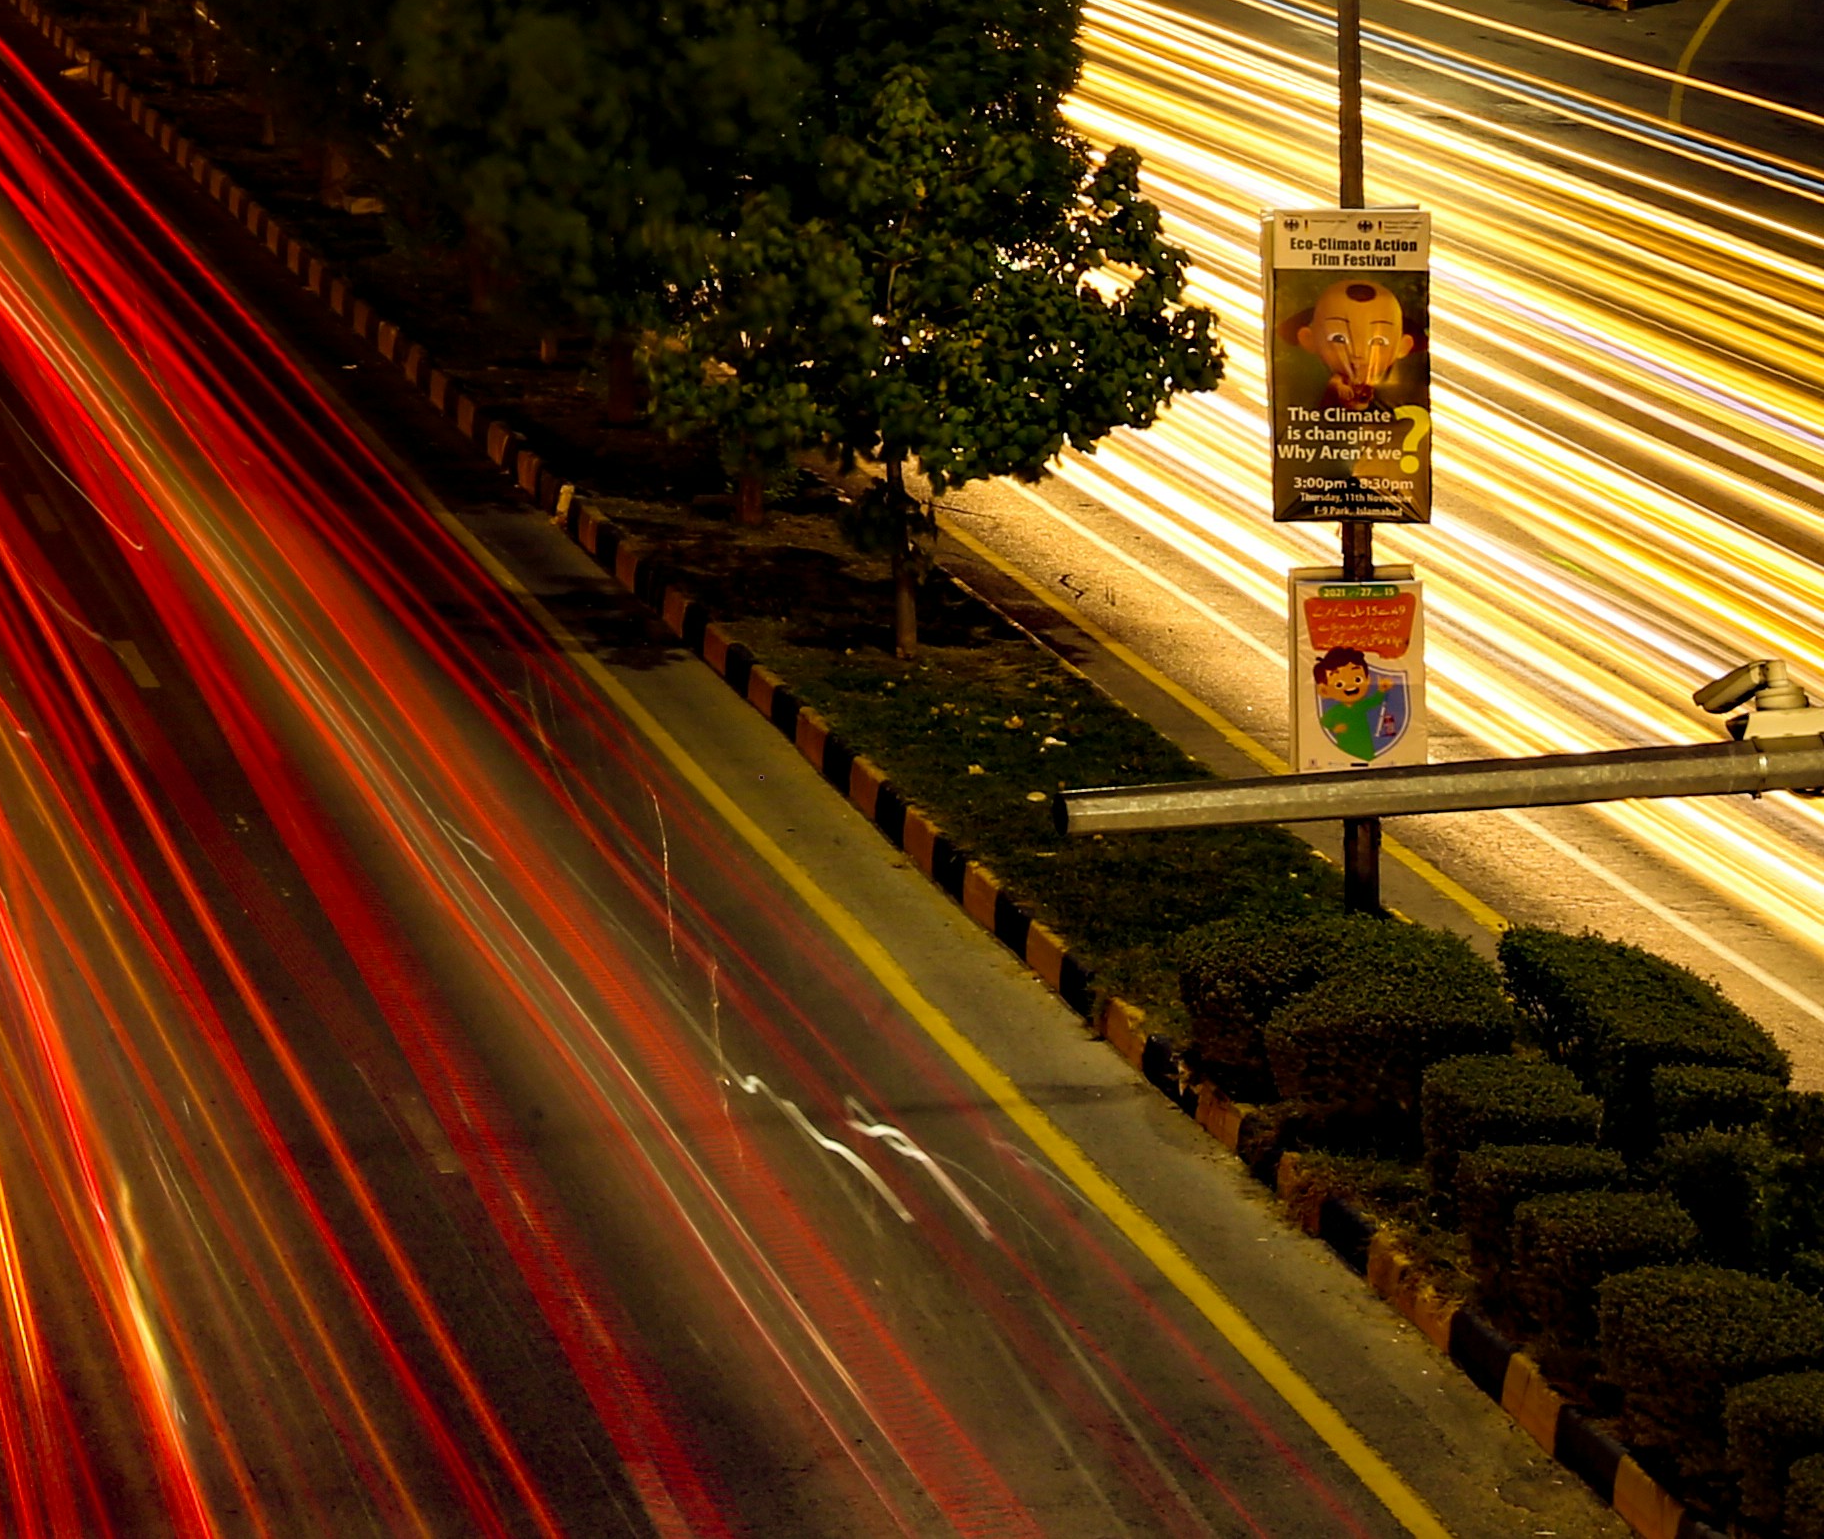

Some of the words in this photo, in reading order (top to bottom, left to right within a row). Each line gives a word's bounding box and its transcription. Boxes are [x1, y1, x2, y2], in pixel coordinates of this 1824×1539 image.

[1289, 237, 1371, 252] Eco-Climate
[1374, 238, 1418, 252] Action
[1311, 252, 1340, 267] Film
[1343, 253, 1396, 267] Festival
[1287, 406, 1320, 422] The
[1324, 407, 1392, 423] Climate
[1287, 426, 1301, 440] is
[1305, 426, 1393, 445] changing;
[1277, 444, 1316, 463] Why
[1319, 444, 1373, 460] Aren't
[1293, 477, 1348, 491] 3:00pm
[1359, 478, 1414, 491] 8:30pm
[1300, 492, 1343, 503] Thursday,
[1345, 492, 1365, 502] 11th
[1356, 506, 1403, 517] Islamabad
[1323, 588, 1345, 598] 2021
[1360, 587, 1372, 597] 27
[1384, 587, 1394, 596] 15
[1366, 605, 1377, 616] 15
